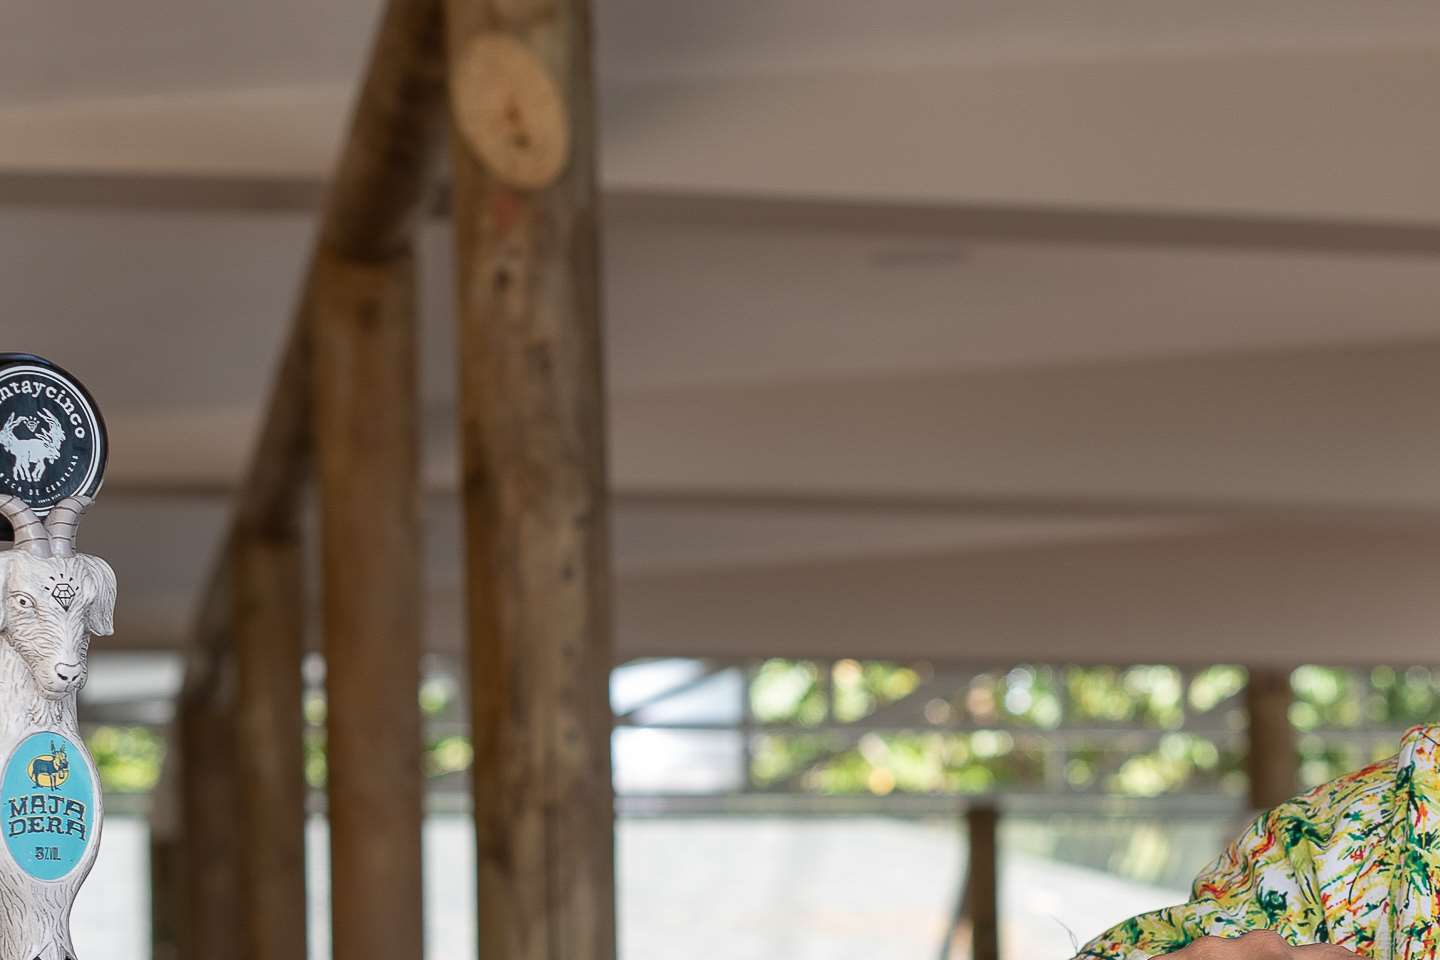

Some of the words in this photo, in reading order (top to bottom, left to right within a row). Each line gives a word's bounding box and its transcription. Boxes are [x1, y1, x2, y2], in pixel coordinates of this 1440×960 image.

[0, 380, 86, 439] ntaycinco
[8, 794, 86, 822] MAJA
[8, 815, 86, 841] DERA
